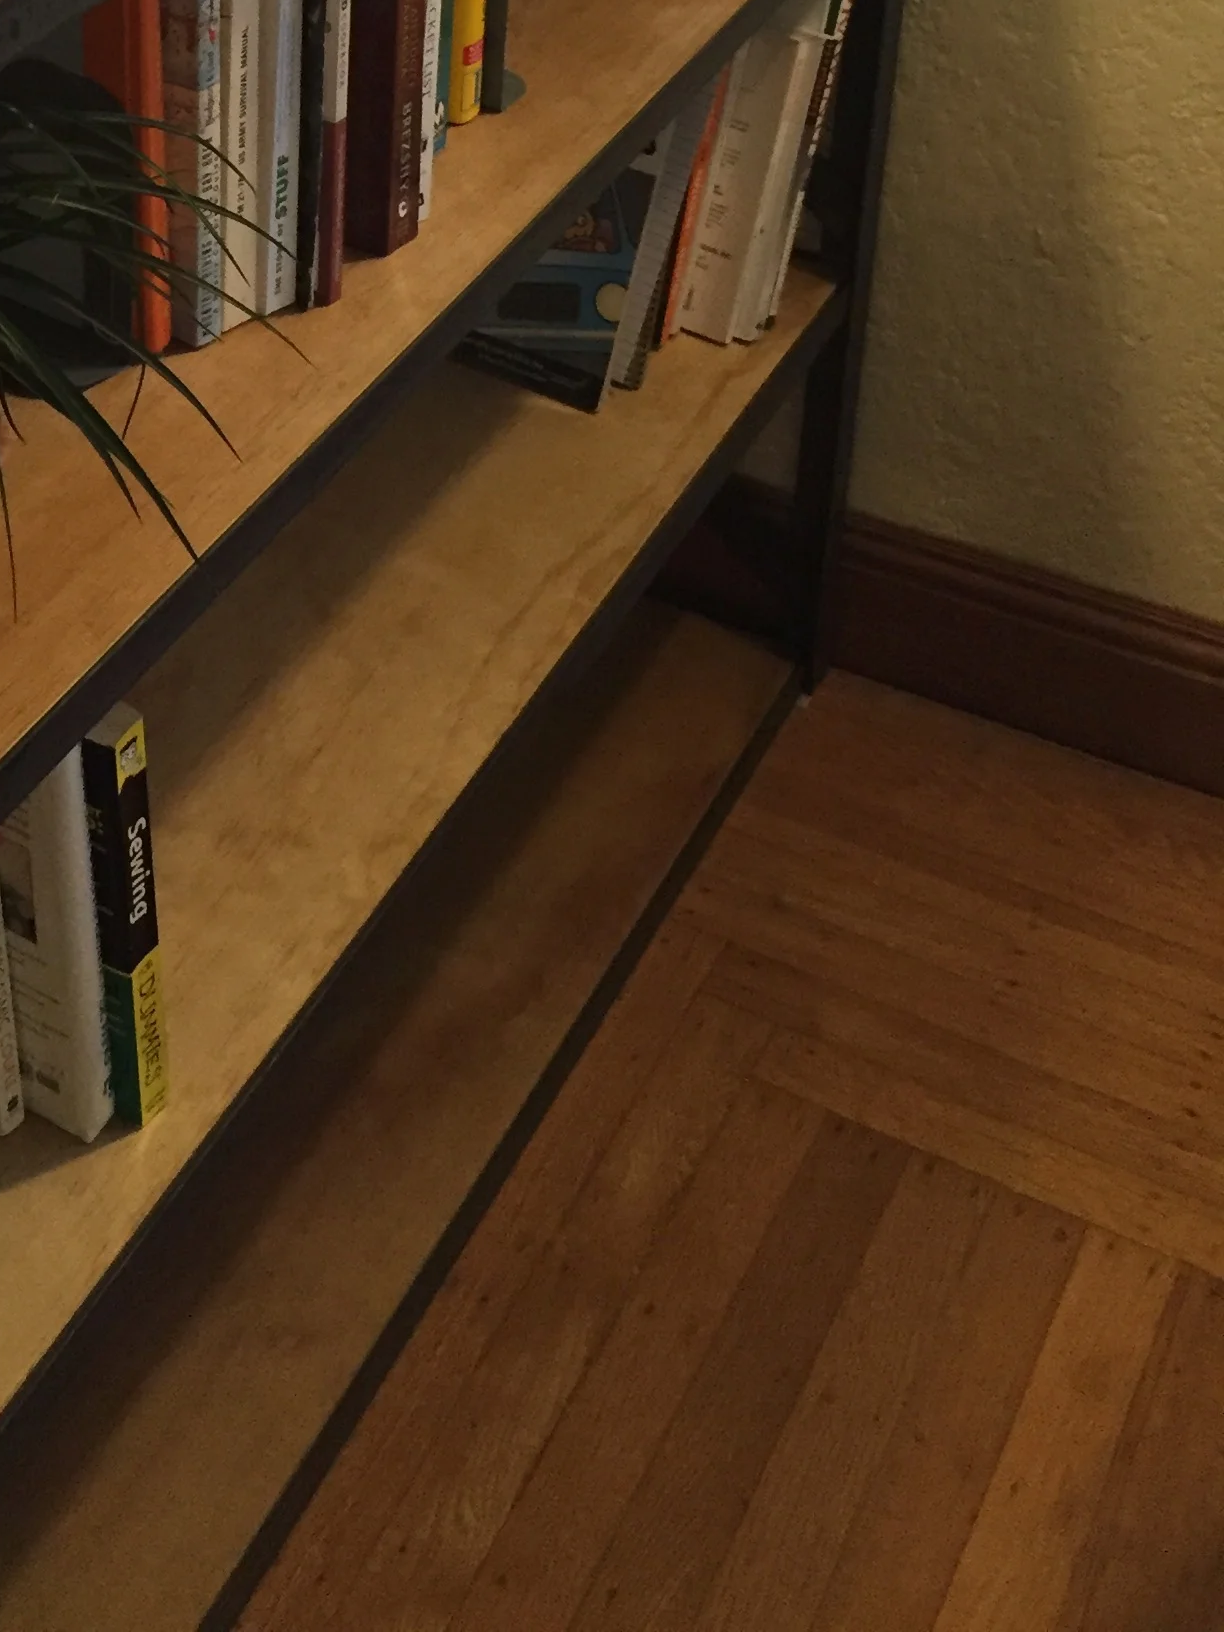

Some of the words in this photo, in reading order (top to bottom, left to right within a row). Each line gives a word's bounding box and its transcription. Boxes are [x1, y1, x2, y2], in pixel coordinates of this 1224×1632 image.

[238, 25, 251, 68] MANUAL
[236, 70, 250, 118] SURVIVAL
[237, 120, 247, 148] ARMY
[237, 150, 246, 165] US
[274, 153, 289, 219] STUFF
[126, 816, 152, 925] Sewing
